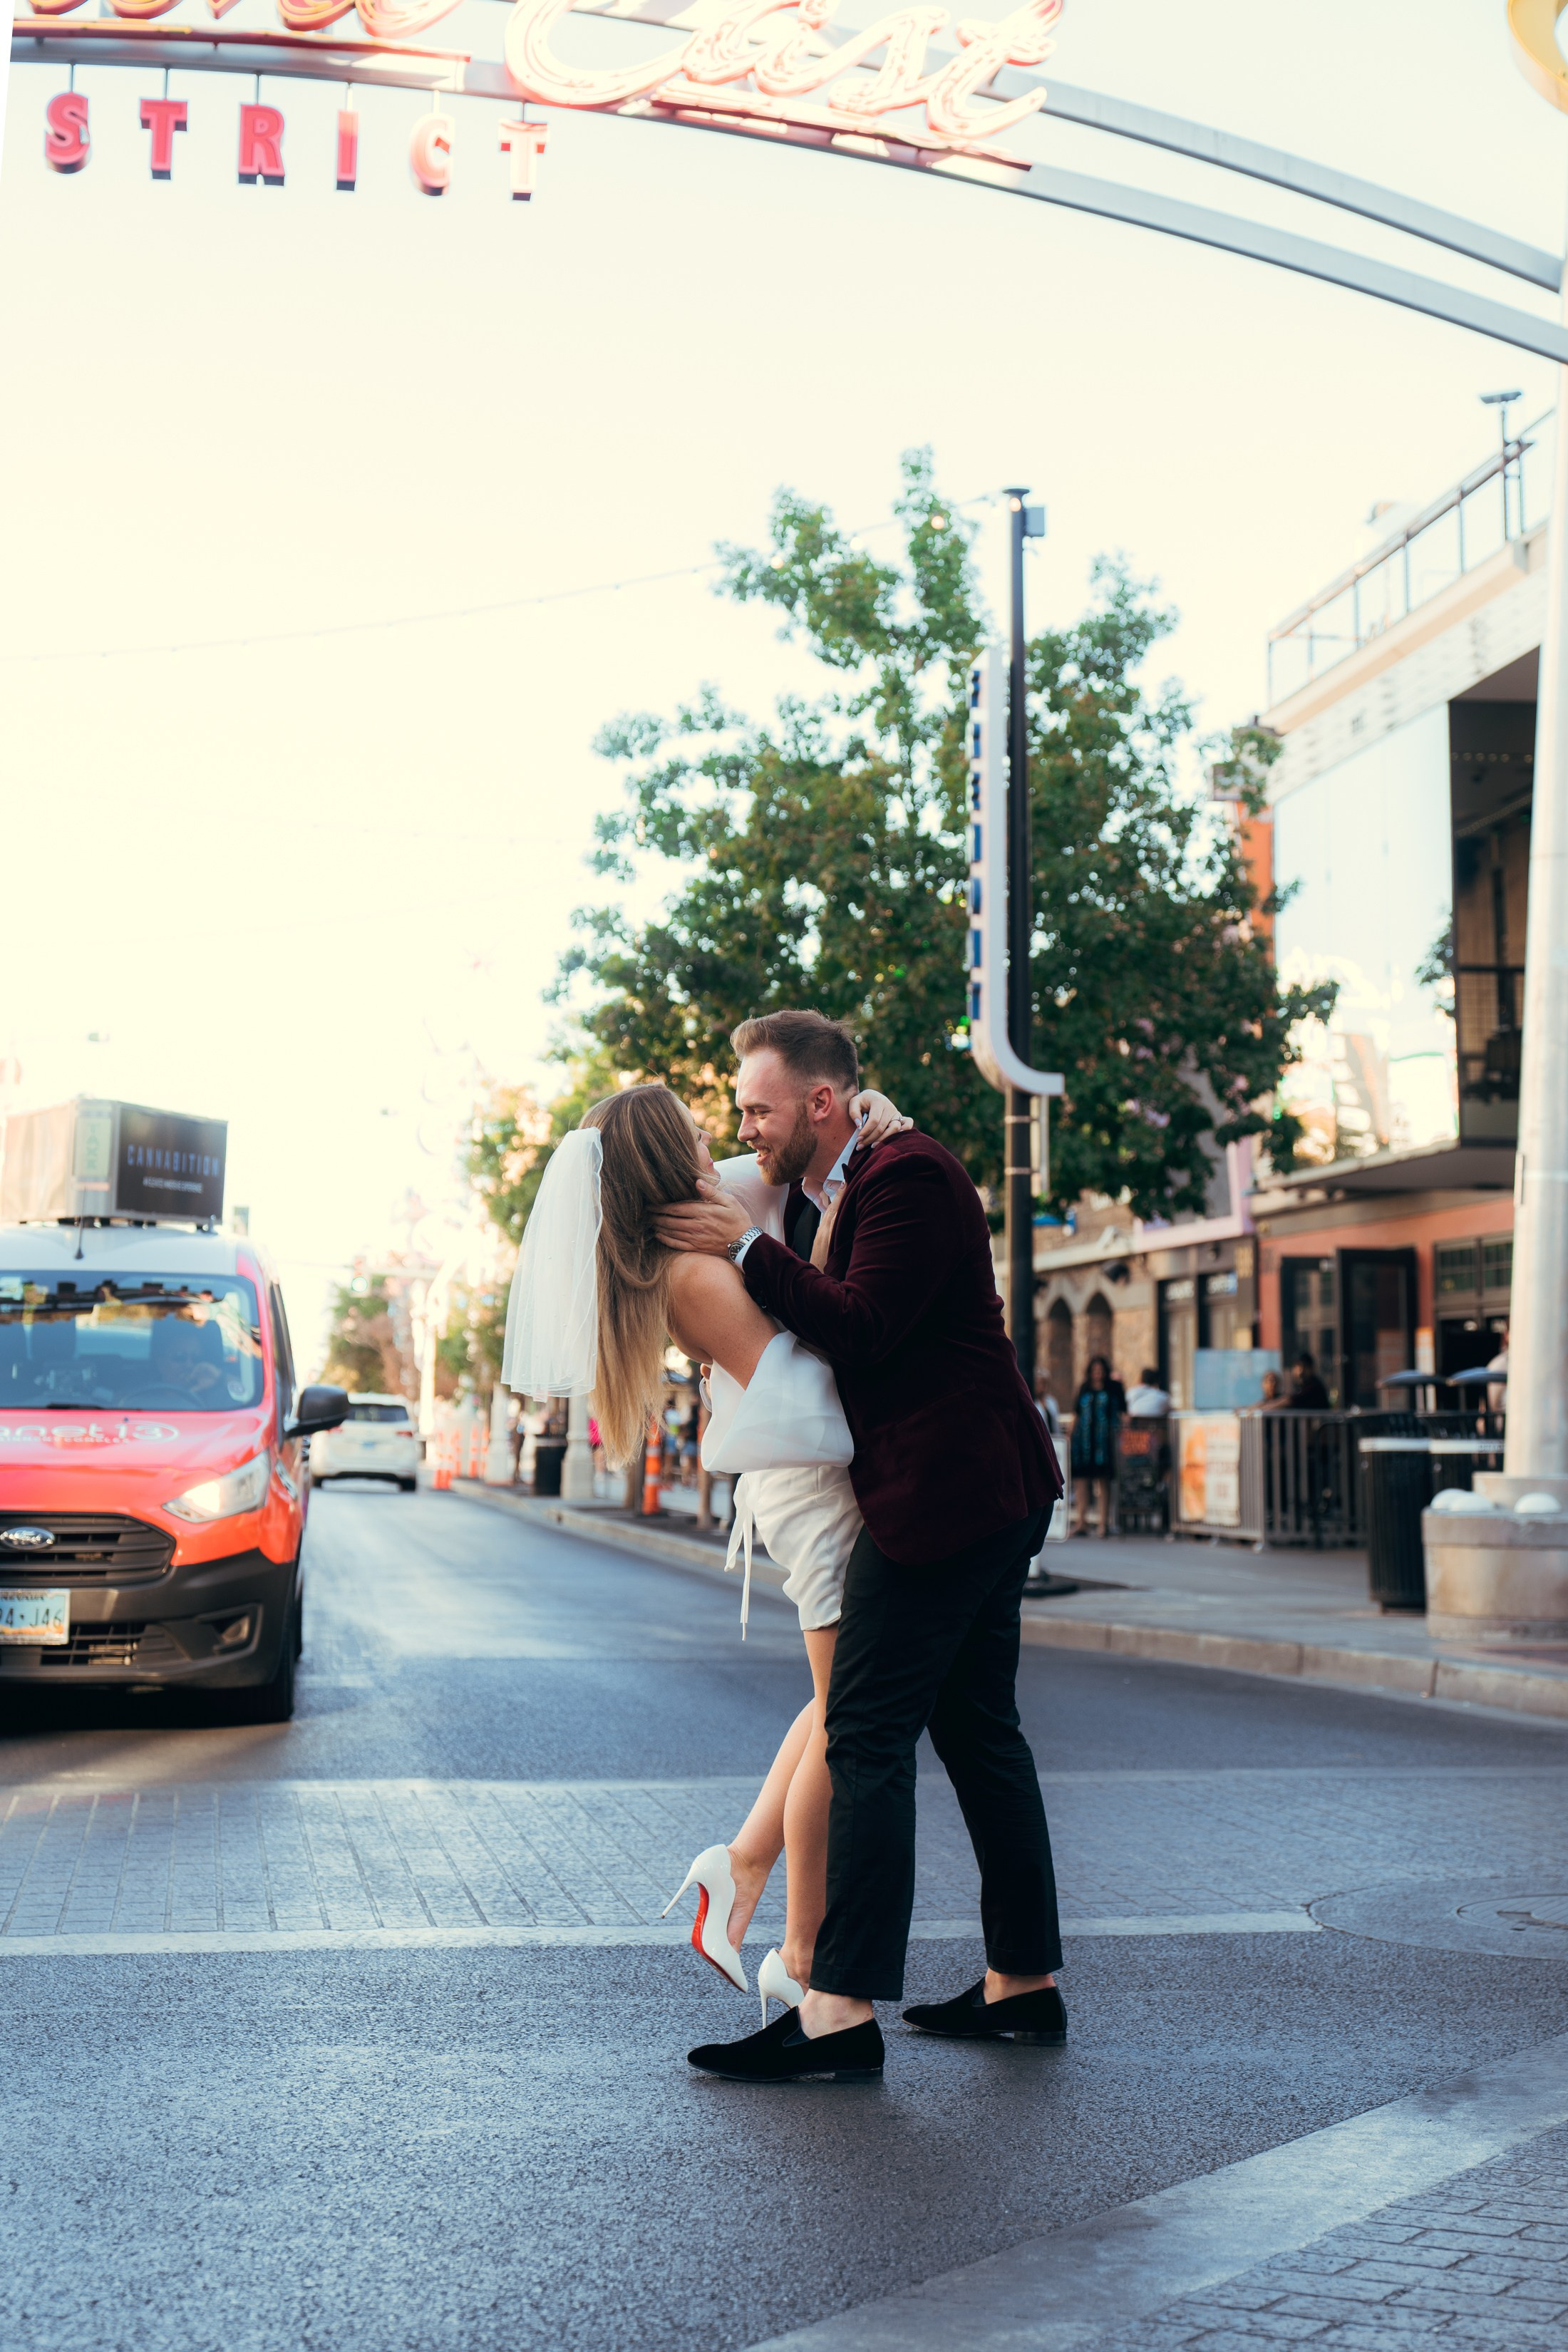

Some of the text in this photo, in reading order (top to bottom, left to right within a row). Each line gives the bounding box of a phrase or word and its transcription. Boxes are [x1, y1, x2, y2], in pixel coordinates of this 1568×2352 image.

[46, 92, 547, 200] STRICT
[127, 1144, 219, 1176] CANNABITION
[115, 1424, 163, 1440] 13
